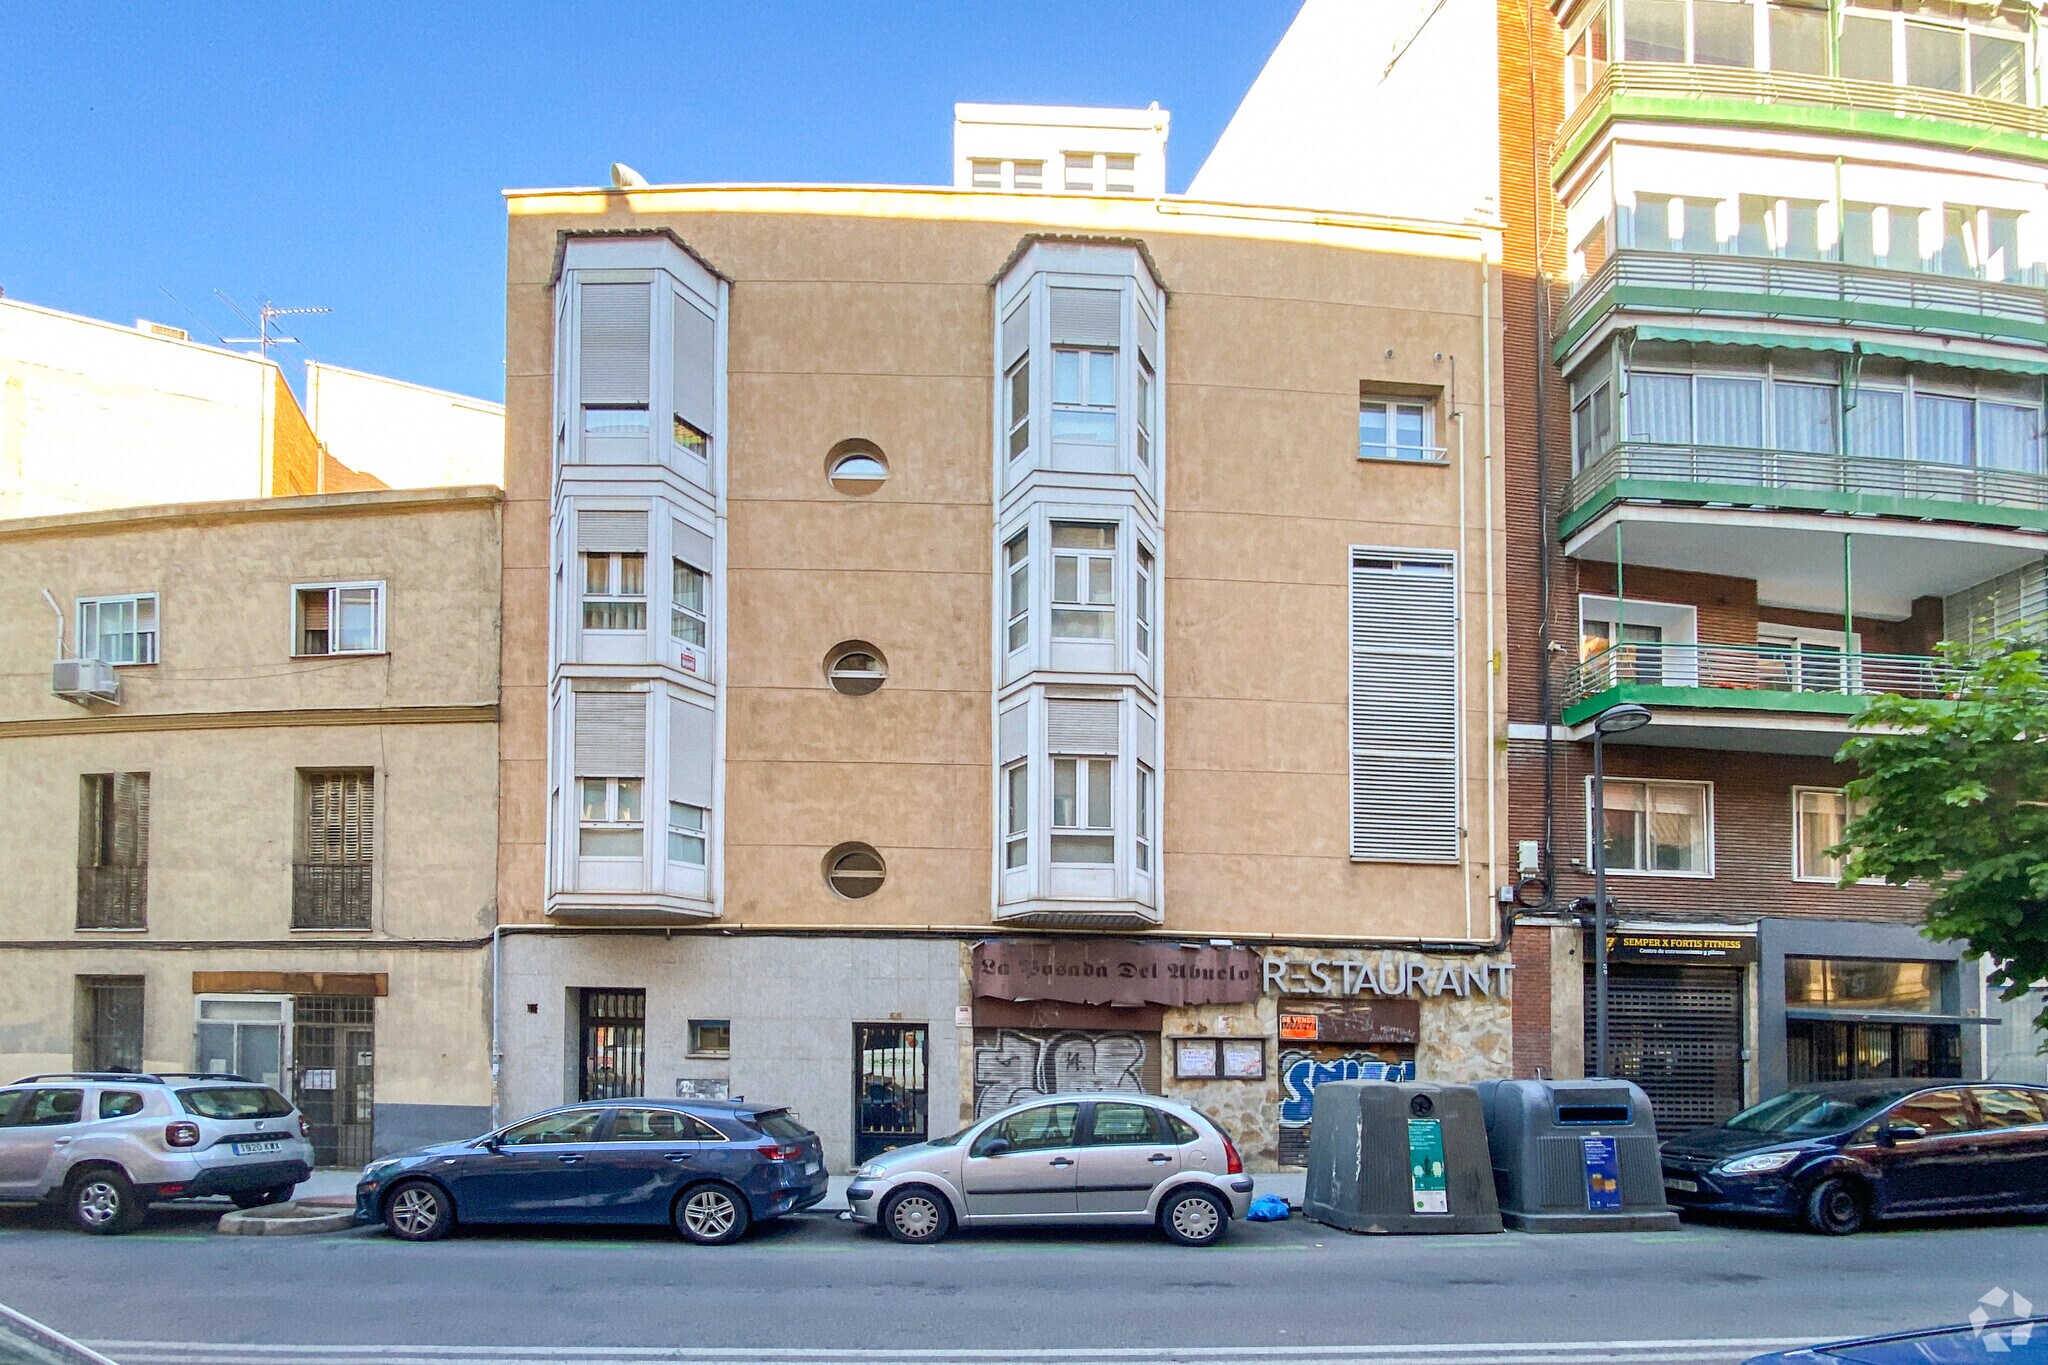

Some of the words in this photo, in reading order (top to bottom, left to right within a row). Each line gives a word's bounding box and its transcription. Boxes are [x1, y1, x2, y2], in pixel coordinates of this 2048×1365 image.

[1623, 938, 1661, 947] SEMPER
[1661, 939, 1669, 947] X
[1670, 939, 1702, 948] FORTIS
[1703, 940, 1741, 949] FITNESS
[980, 958, 1010, 976] La
[1019, 958, 1108, 979] Posada
[1117, 961, 1158, 979] Del
[1167, 962, 1250, 981] Abuelo
[1262, 958, 1517, 997] RESTAURANT
